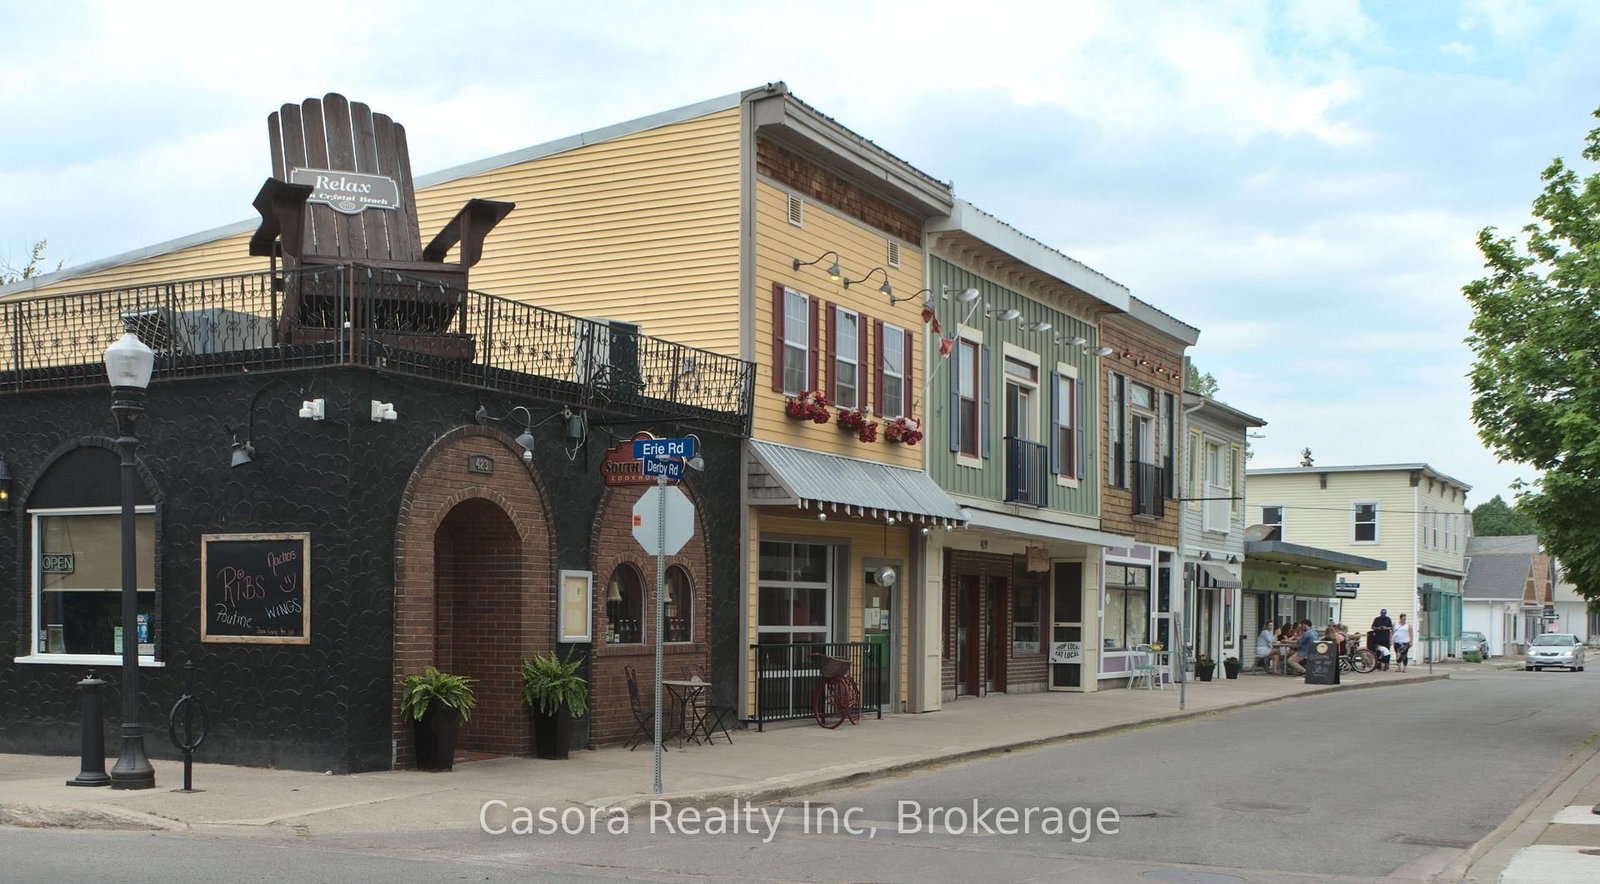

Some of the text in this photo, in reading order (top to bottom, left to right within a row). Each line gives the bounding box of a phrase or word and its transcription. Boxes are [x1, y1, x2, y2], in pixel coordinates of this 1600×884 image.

[316, 175, 371, 194] Relax
[643, 442, 684, 455] Erie Rd
[475, 458, 489, 470] 423
[605, 460, 641, 473] SOUTH
[647, 460, 679, 477] Derby Rd
[43, 557, 73, 569] OPEN
[215, 602, 253, 629] Poutine
[265, 598, 302, 620] WINGS
[1064, 651, 1079, 659] LOCAL
